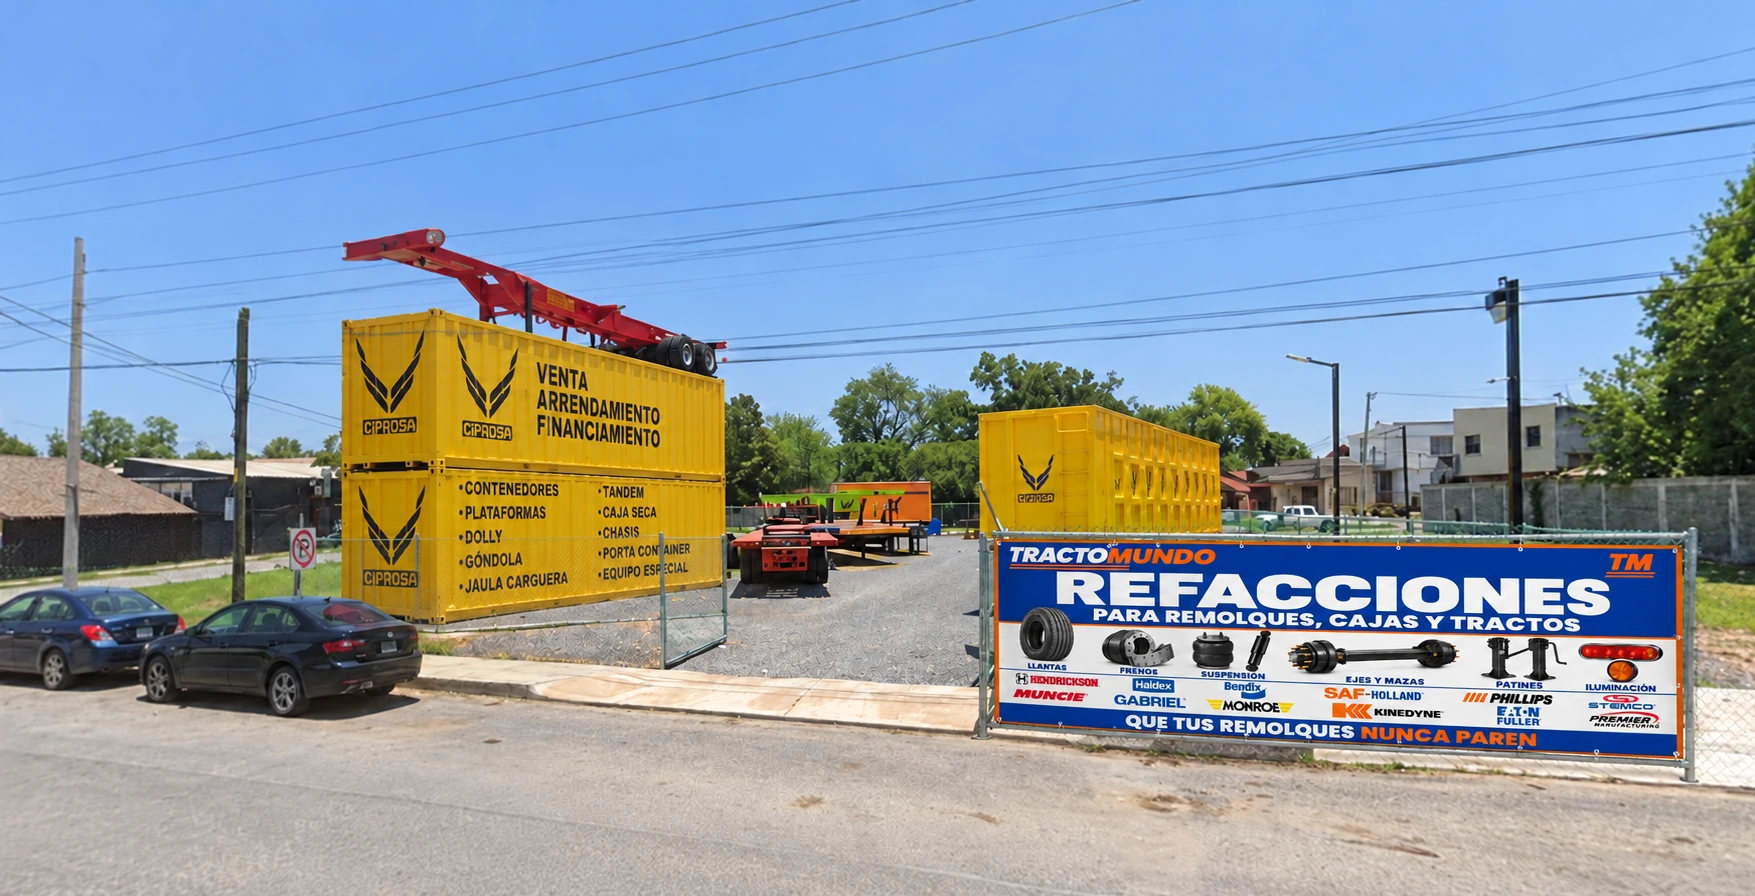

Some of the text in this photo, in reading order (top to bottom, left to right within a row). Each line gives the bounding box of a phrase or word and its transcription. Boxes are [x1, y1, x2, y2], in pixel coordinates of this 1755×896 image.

[536, 362, 588, 391] VENTA
[536, 389, 660, 425] ARRENDAMIENTO
[536, 414, 660, 448] FINANCIAMIENTO
[465, 481, 559, 496] CONTENEDORES
[603, 485, 644, 499] TANDEM
[465, 506, 546, 520] PLATAFORMAS
[603, 506, 657, 518] CAJA SECA
[465, 529, 503, 544] DOLLY
[603, 526, 640, 539] CHASIS
[603, 543, 691, 559] PORTA CONAINER
[1009, 546, 1216, 566] TRACTOMUNDO
[465, 551, 523, 569] GÓNDOLA
[1609, 553, 1653, 571] TM
[603, 566, 641, 581] EQUIPO
[465, 571, 568, 593] JAULA CARGUERA
[1056, 571, 1611, 616] REFACCIONES
[1093, 608, 1581, 632] PARA REMOLQUES, CAJAS Y TRACTOS
[1027, 662, 1067, 671] LLANTAS
[1030, 675, 1099, 687] HENDRICKSON
[1135, 680, 1173, 691] Haldex
[1224, 682, 1261, 692] Bendix
[1345, 676, 1425, 686] EJES Y MAZAS
[1495, 681, 1543, 690] PATINES
[1585, 683, 1656, 693] ILUMINACIÓN
[1013, 688, 1087, 702] MUNCIE
[1113, 694, 1187, 708] GABRIEL
[1324, 687, 1422, 701] SAF-HOLLAND
[1489, 693, 1553, 705] PHILLIPS
[1222, 700, 1280, 713] MONROE
[1374, 708, 1442, 718] KINEDYNE
[1588, 702, 1655, 710] STEMCO
[1497, 717, 1541, 726] FULLER
[1589, 715, 1651, 724] PREMIER
[1125, 714, 1537, 746] QUE TUS REMOLQUES NUNCA PAREN
